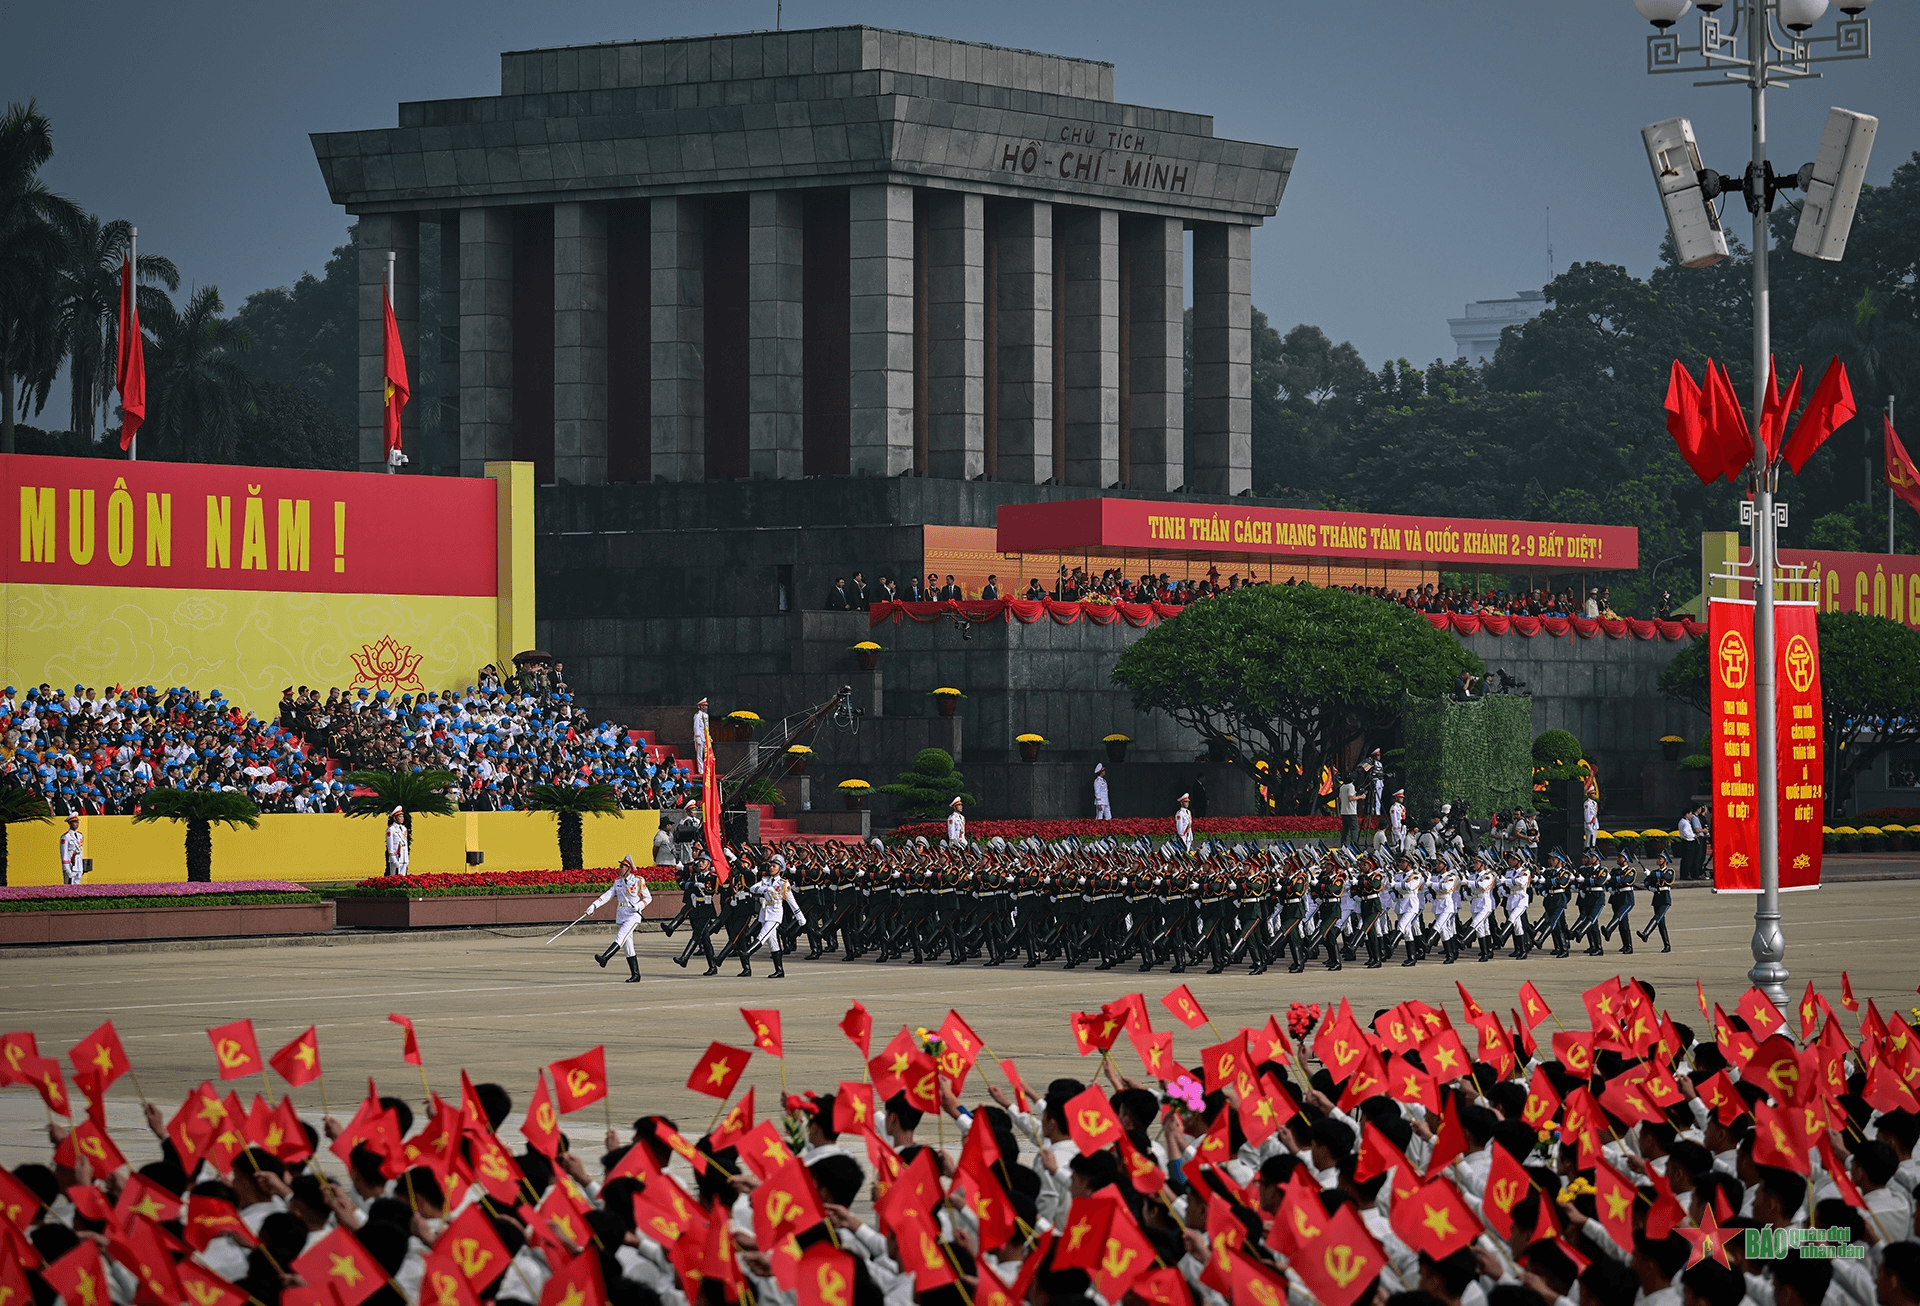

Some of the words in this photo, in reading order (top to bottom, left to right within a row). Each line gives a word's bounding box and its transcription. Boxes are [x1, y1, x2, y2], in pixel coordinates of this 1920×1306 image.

[1061, 123, 1095, 144] CHỦ
[20, 477, 171, 567] MUÔN
[207, 484, 311, 572] NĂM
[1148, 516, 1185, 540] TINH
[1189, 512, 1230, 542] THẦN
[1234, 516, 1272, 544] CÁCH
[1276, 523, 1316, 550] MẠNG
[1320, 522, 1367, 550] THÁNG
[1370, 524, 1401, 550] TÁM
[1404, 525, 1422, 551] VÀ
[1425, 525, 1460, 554] QUỐC
[1463, 529, 1508, 556] KHÁNH
[1511, 534, 1535, 557] 2-9
[1538, 530, 1564, 557] BẤT
[1855, 563, 1920, 626] CÔNG
